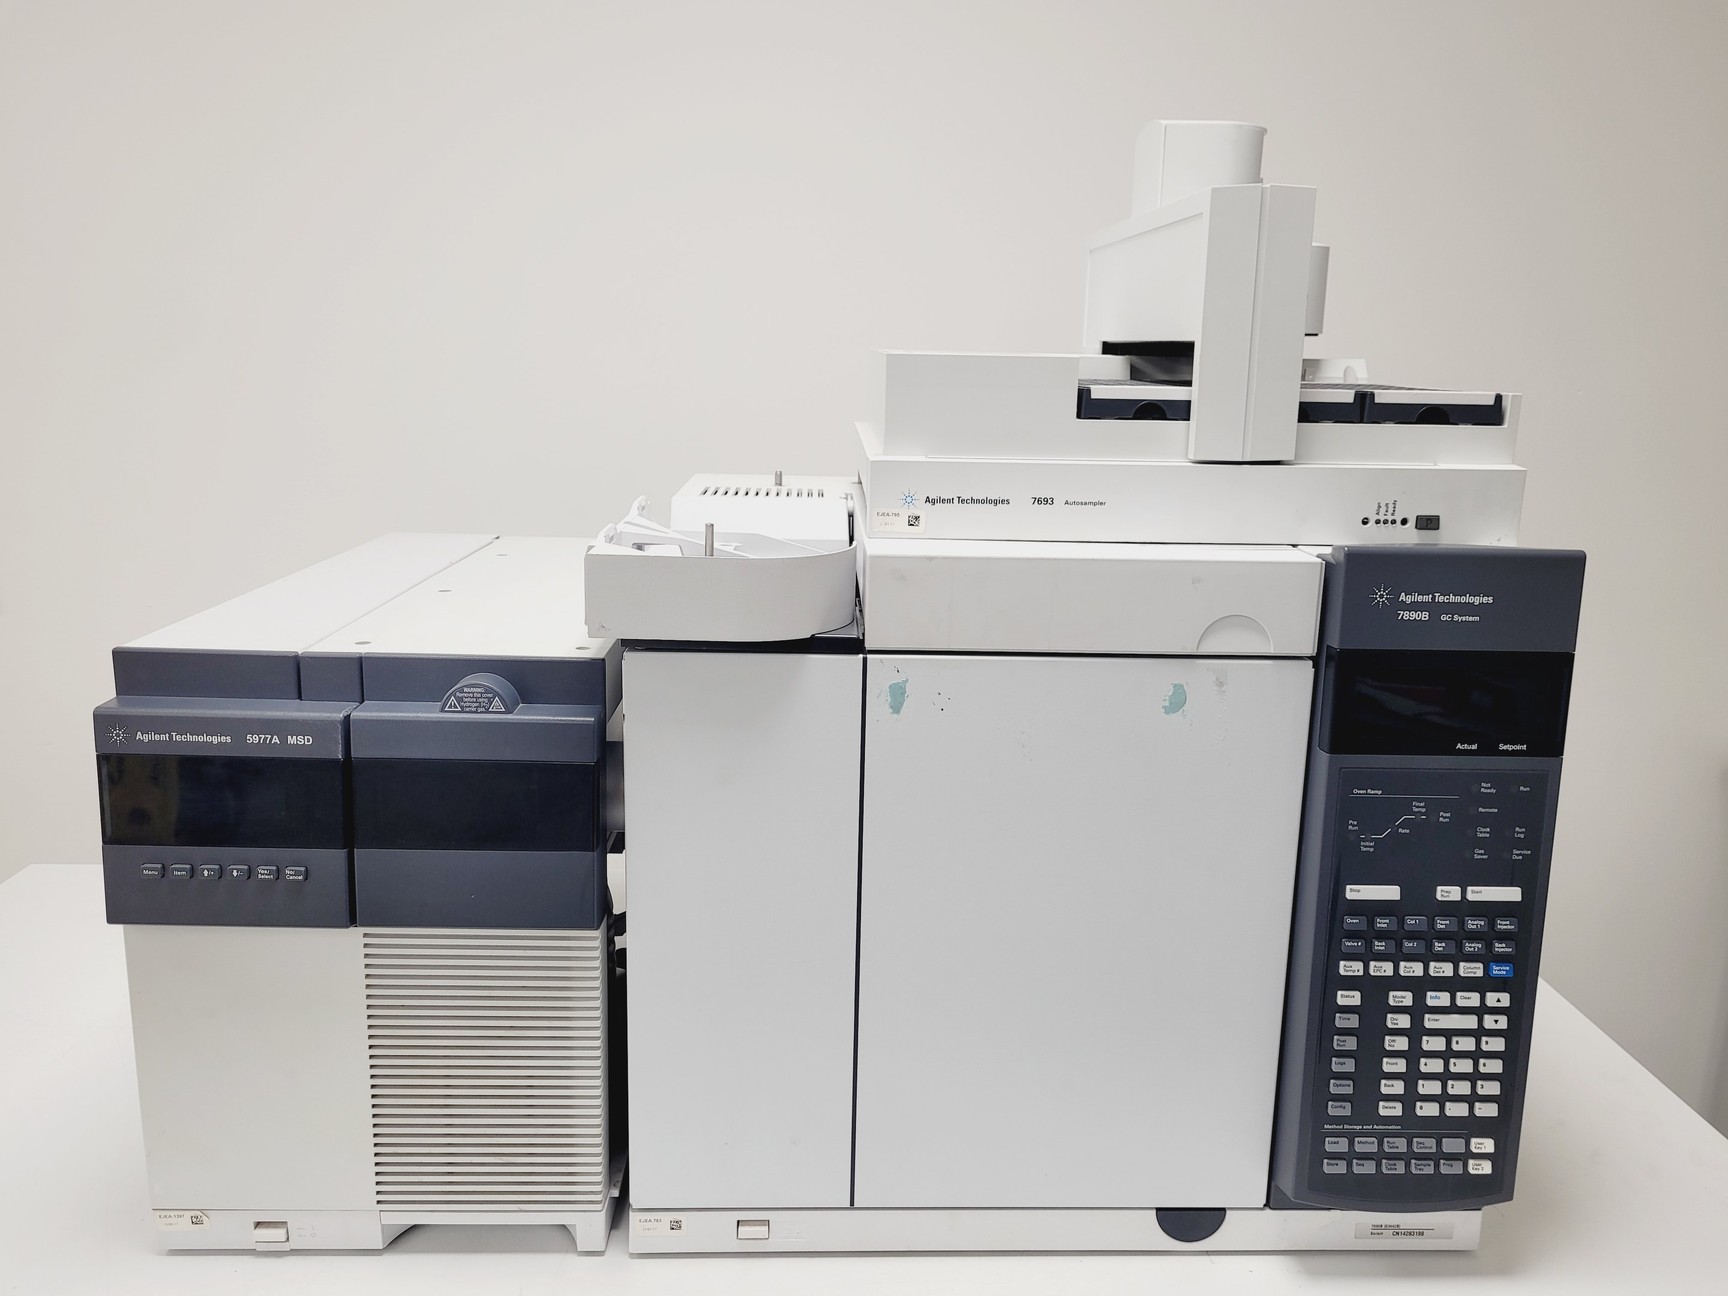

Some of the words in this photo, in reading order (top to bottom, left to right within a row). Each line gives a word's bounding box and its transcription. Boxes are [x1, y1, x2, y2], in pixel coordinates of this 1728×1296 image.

[924, 496, 955, 506] Agilent
[956, 496, 1010, 506] Technologies
[1031, 497, 1054, 506] 7693
[1399, 592, 1432, 604] Agilent
[1434, 593, 1493, 605] Technologies
[1397, 611, 1429, 621] 7890B
[1453, 614, 1480, 622] System
[136, 731, 169, 743] Agilent
[171, 732, 231, 744] Technologies
[246, 734, 280, 744] 5977A
[287, 736, 313, 745] MSD
[1498, 743, 1527, 752] Setpoint
